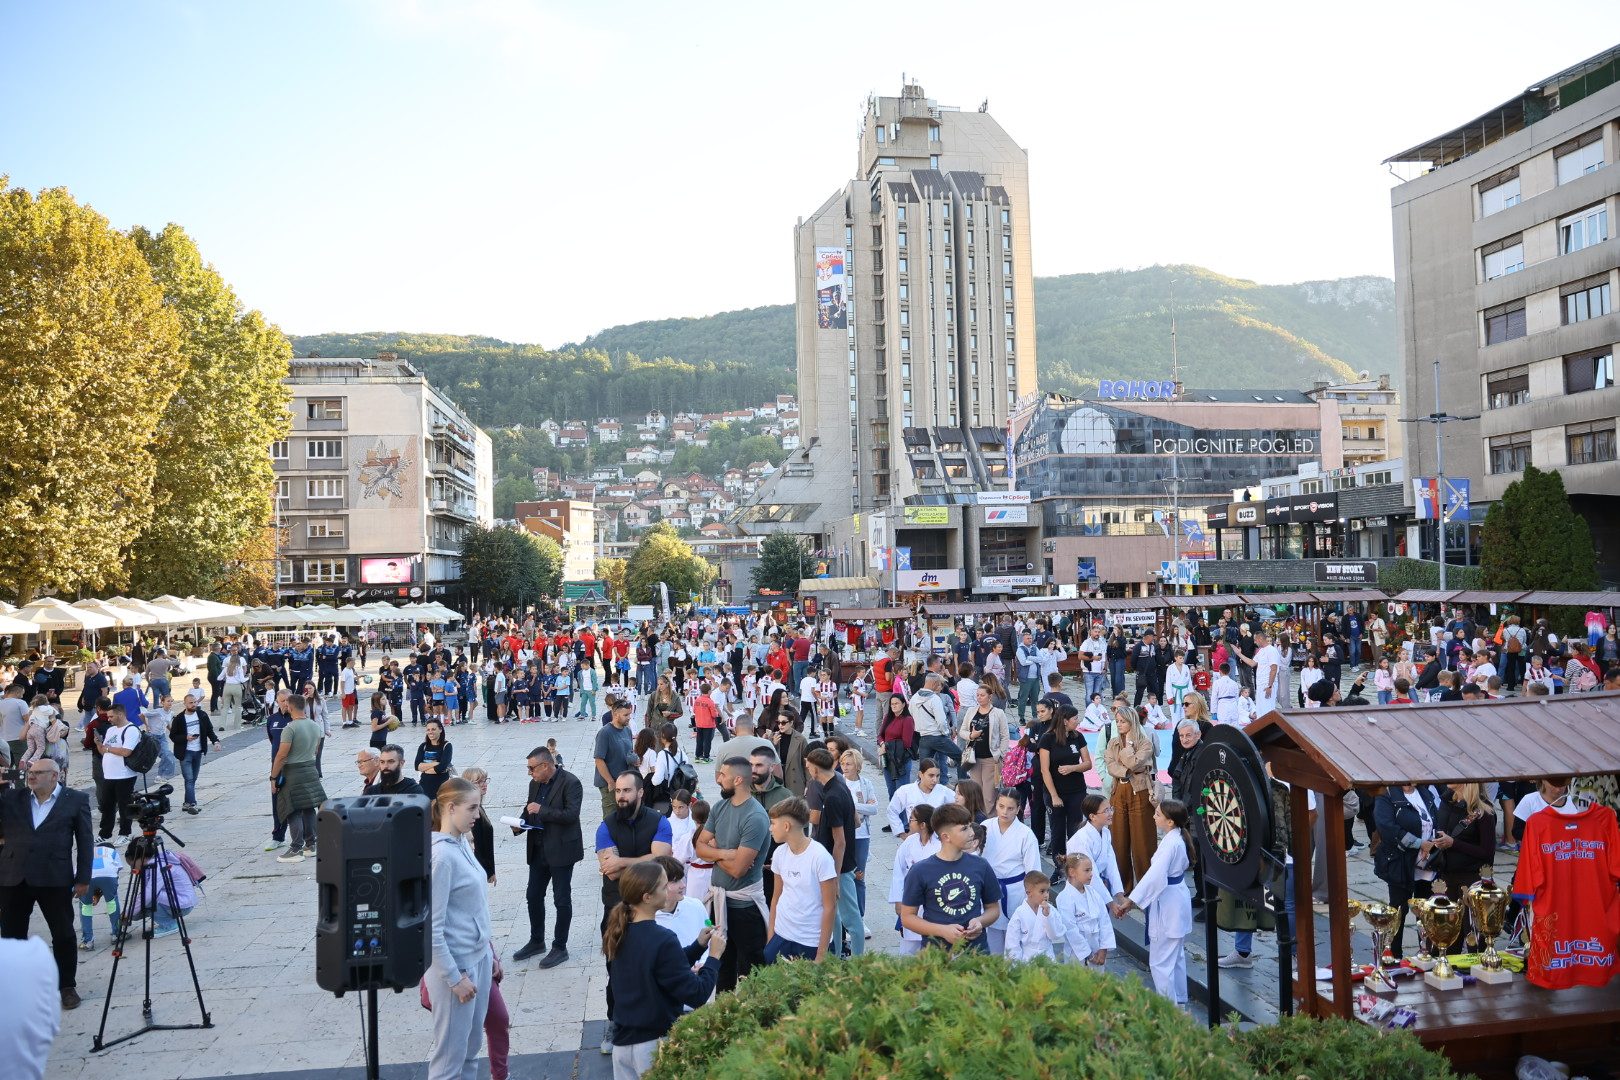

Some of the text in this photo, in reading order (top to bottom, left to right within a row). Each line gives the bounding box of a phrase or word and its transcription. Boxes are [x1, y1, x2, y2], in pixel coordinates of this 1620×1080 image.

[1098, 380, 1175, 398] BOHOR
[1154, 438, 1314, 453] PODIGNITE POGLED
[1326, 565, 1341, 574] NEW
[921, 573, 938, 582] dm
[1573, 838, 1605, 850] Team
[1555, 849, 1595, 861] Serbia
[938, 872, 970, 886] JUST DO IT.
[943, 905, 957, 916] JUST
[1554, 937, 1604, 954] Uroš
